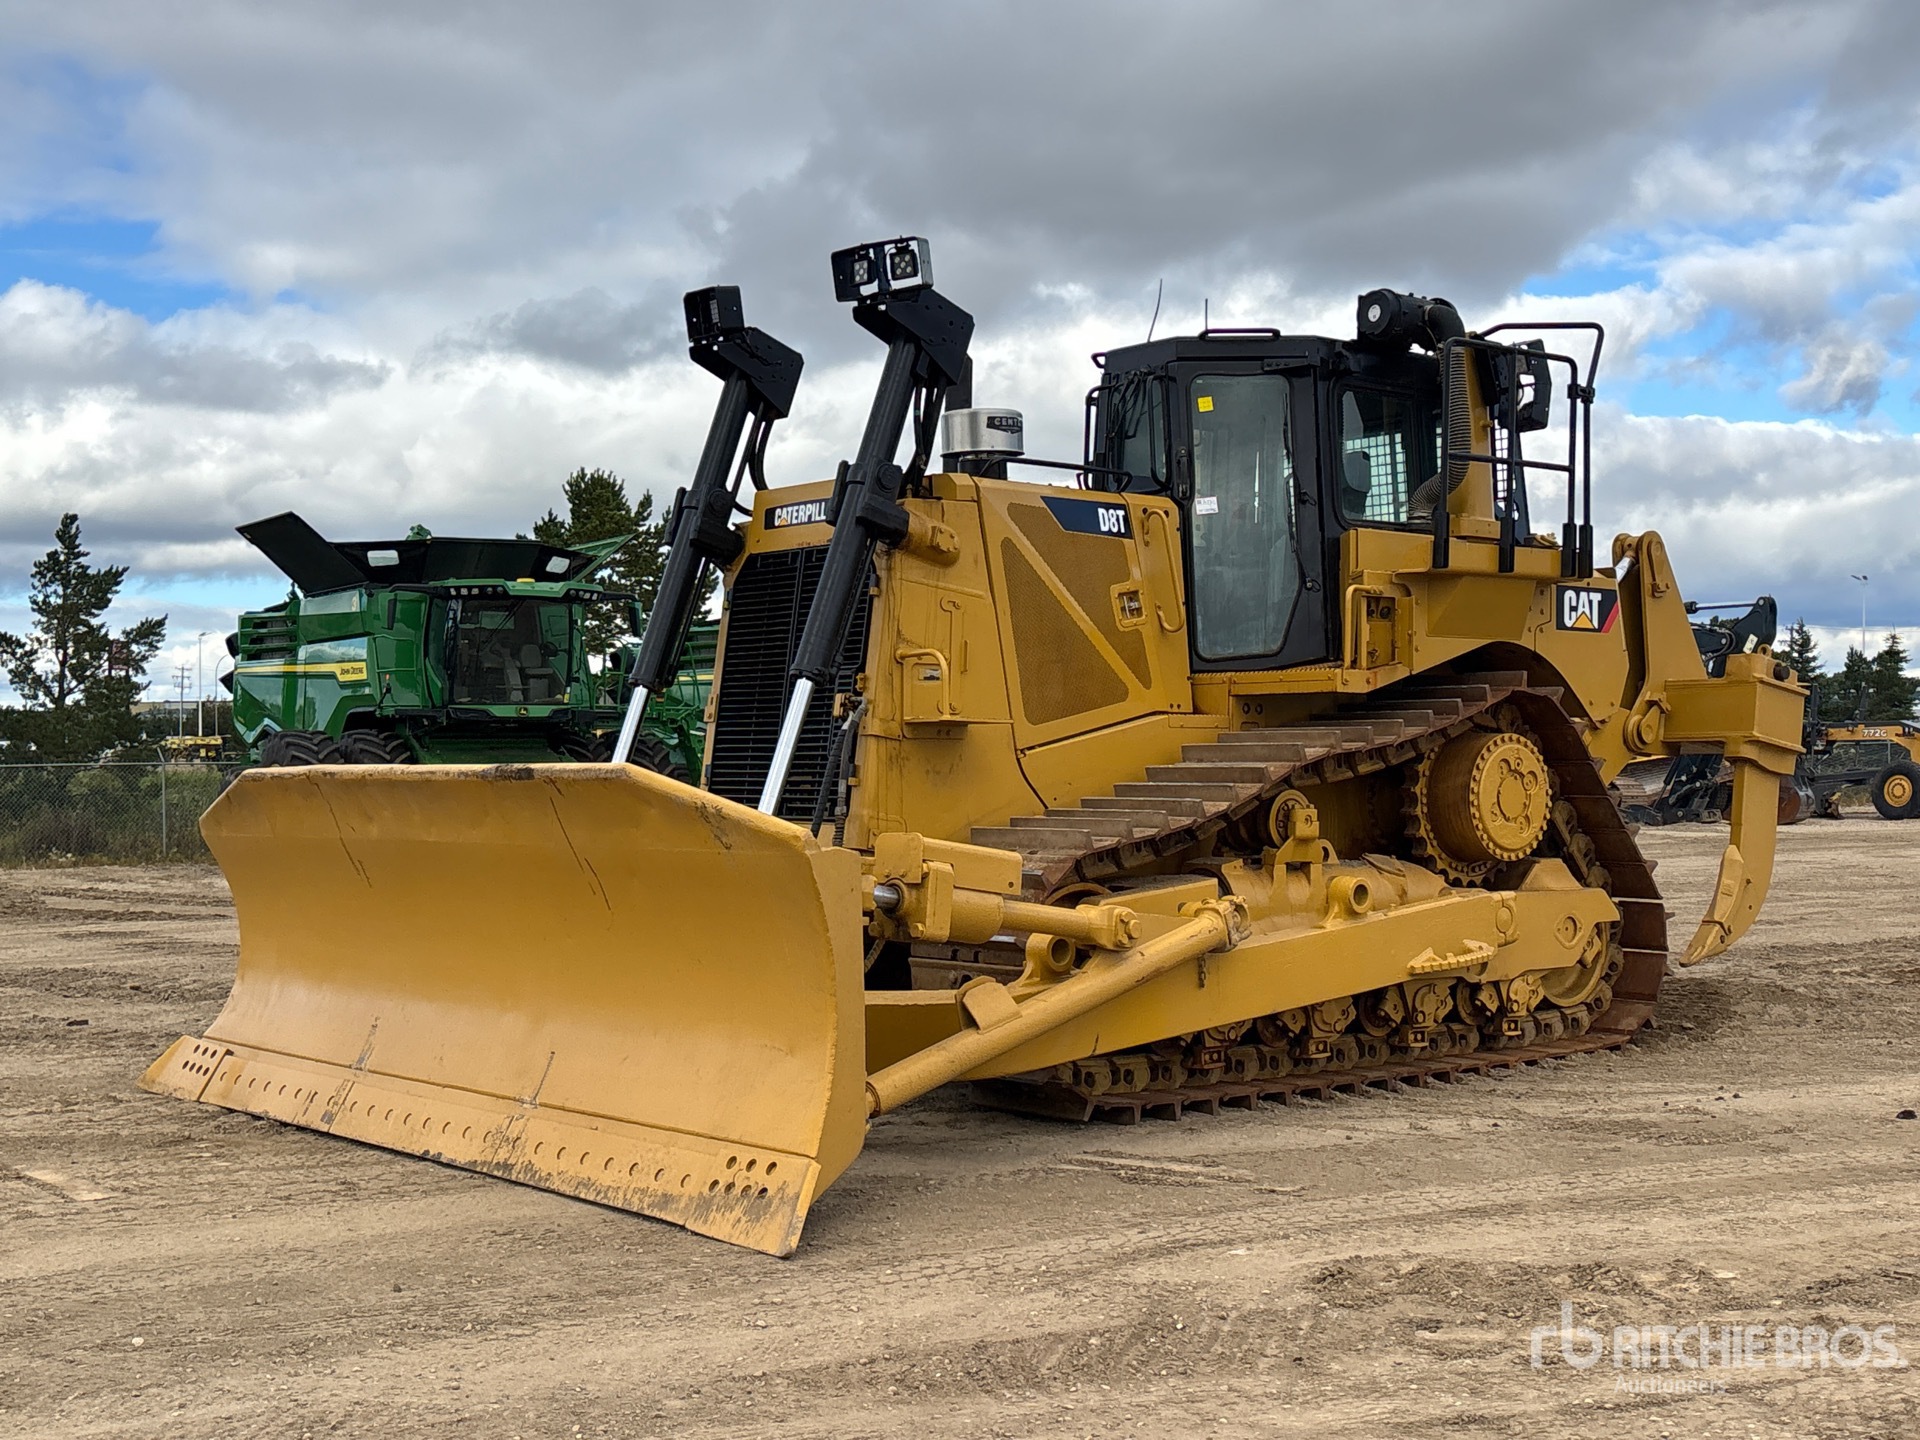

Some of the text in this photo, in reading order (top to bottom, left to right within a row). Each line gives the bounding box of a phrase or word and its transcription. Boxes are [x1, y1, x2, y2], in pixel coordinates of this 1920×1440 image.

[774, 501, 827, 527] CATERPILL
[1097, 507, 1126, 534] D8T
[1563, 589, 1602, 629] CAT
[1862, 729, 1887, 737] 772G
